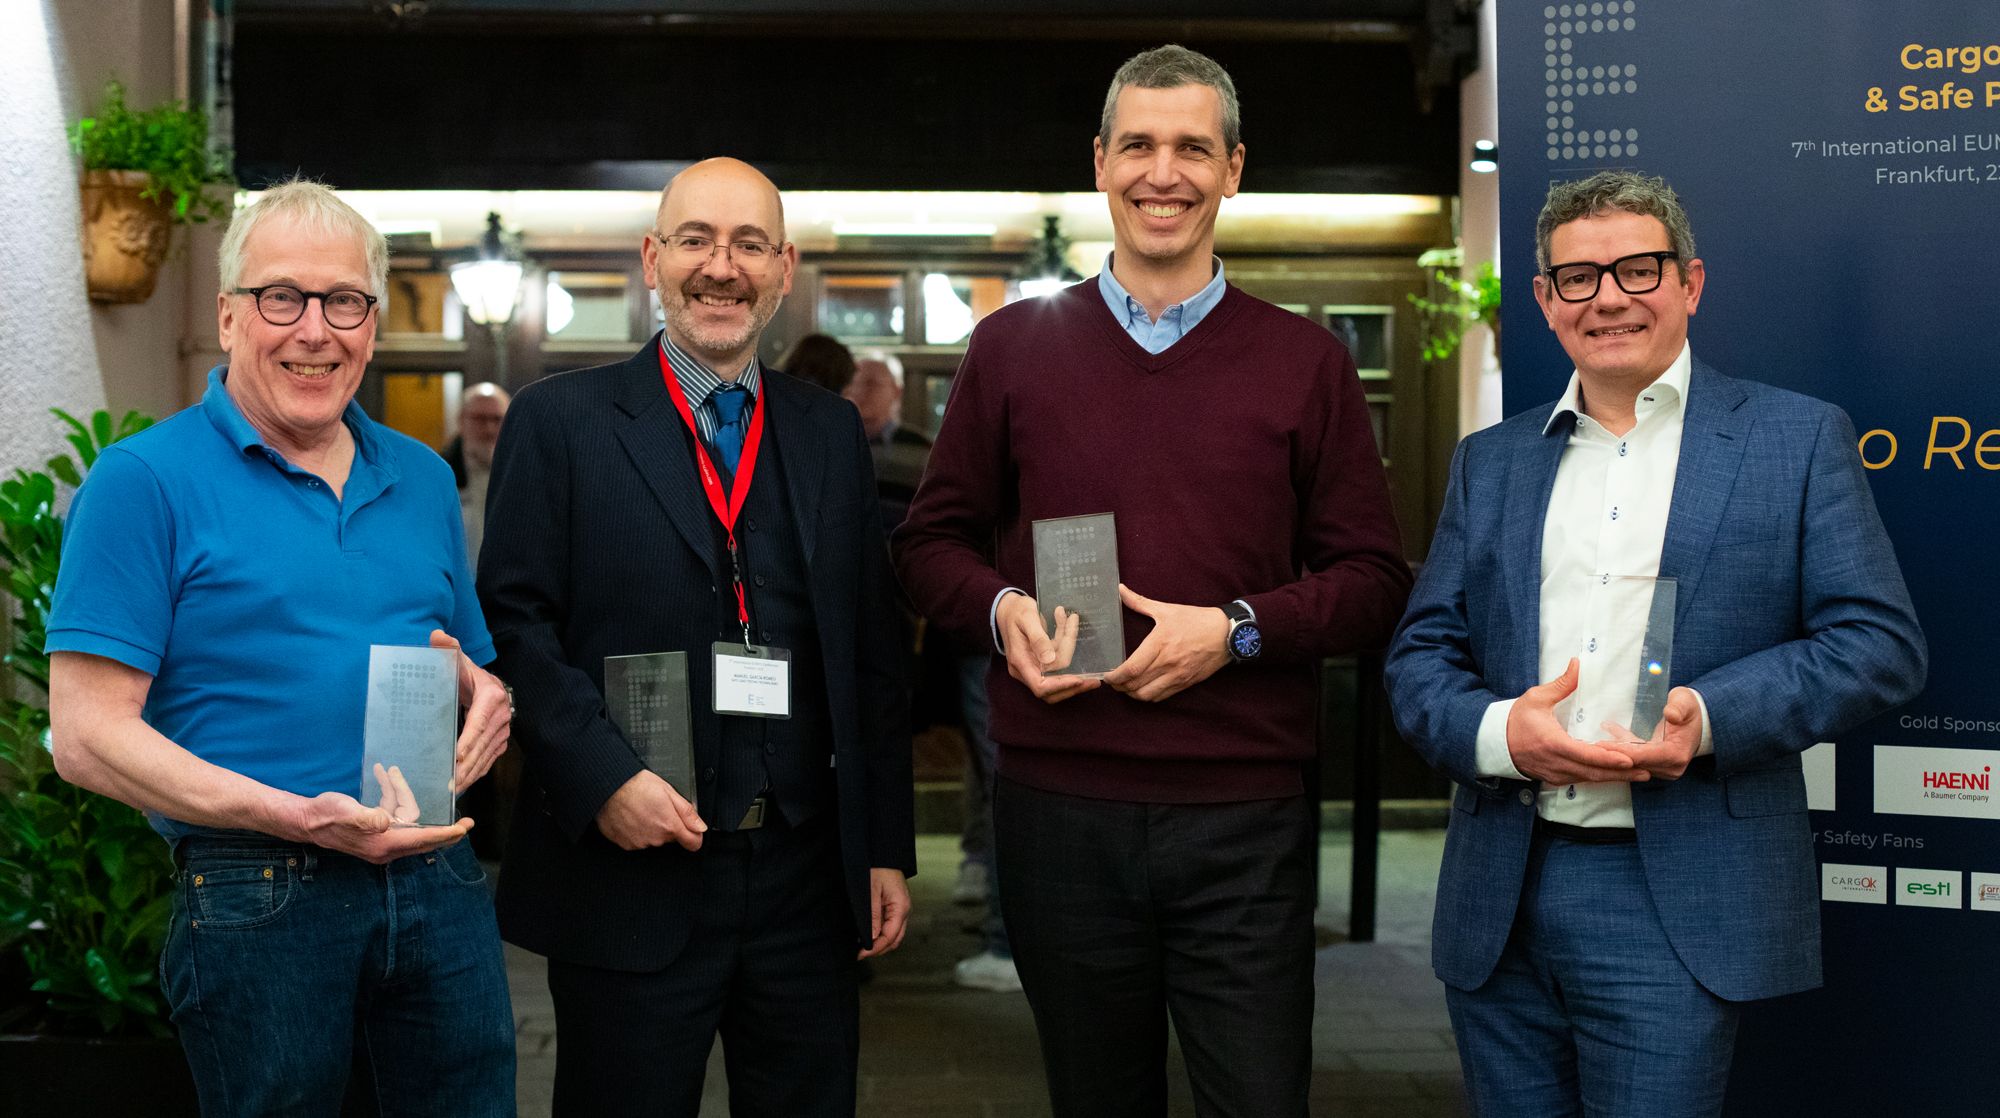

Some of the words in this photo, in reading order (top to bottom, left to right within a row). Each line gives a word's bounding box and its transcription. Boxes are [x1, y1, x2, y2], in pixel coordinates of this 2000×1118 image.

[1901, 43, 2000, 74] Cargo
[1865, 87, 1888, 113] &
[1898, 82, 1974, 111] Safe
[1822, 135, 1957, 157] International
[1964, 133, 2000, 152] EU
[1876, 165, 1981, 185] Frankfurt,
[1986, 165, 2000, 181] 2
[1923, 416, 2000, 471] Re
[1899, 716, 1938, 730] Gold
[1930, 791, 1956, 799] Baumer
[1957, 793, 1989, 803] Company
[1824, 830, 1878, 850] Safety
[1883, 833, 1924, 849] Fans
